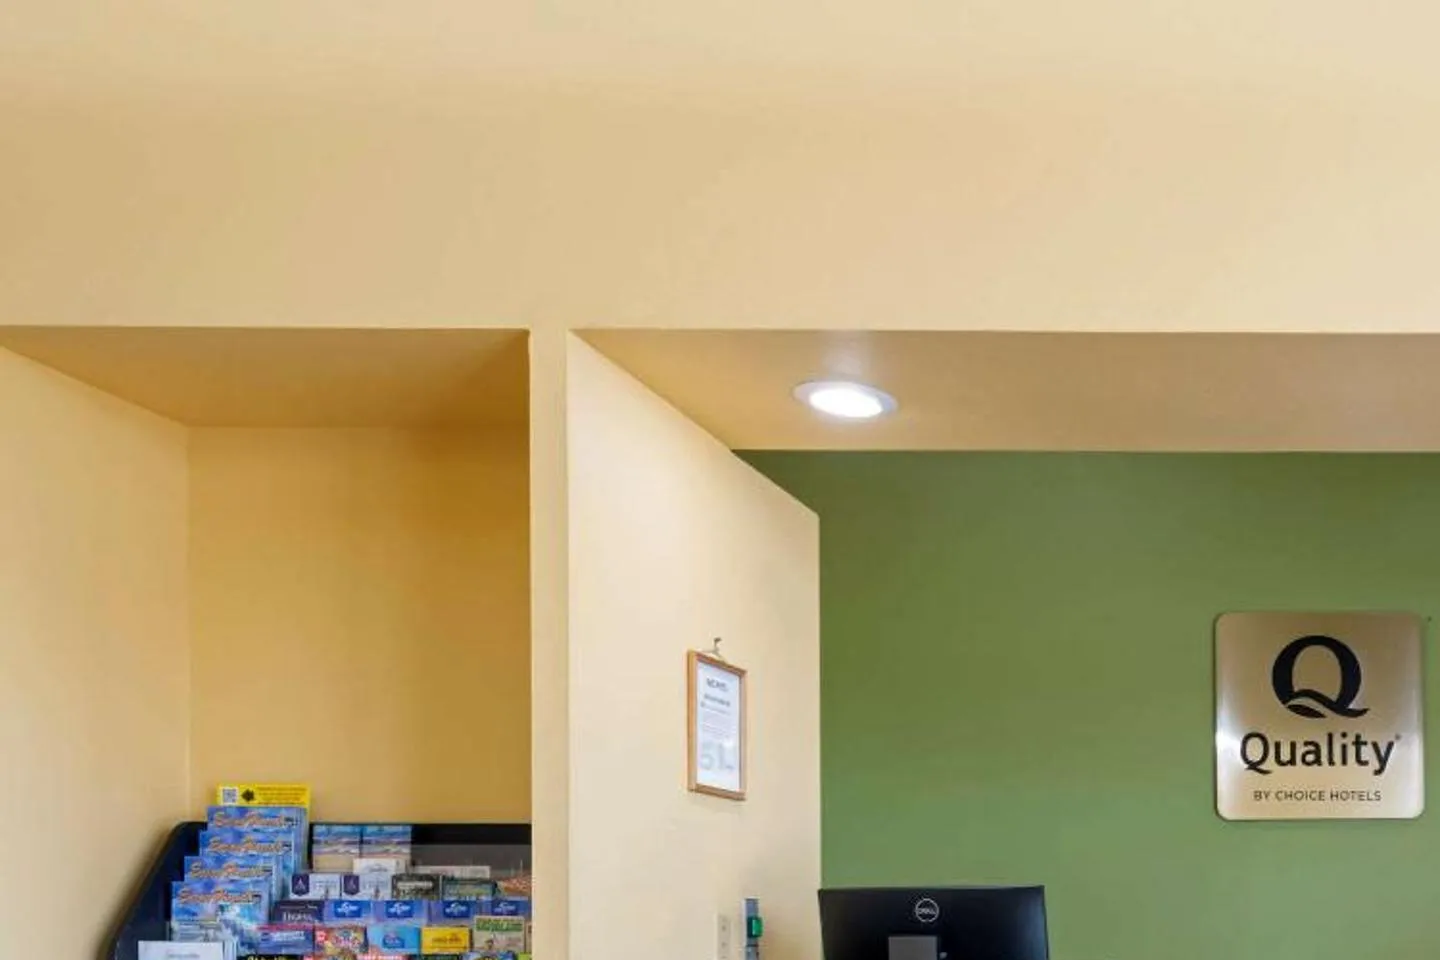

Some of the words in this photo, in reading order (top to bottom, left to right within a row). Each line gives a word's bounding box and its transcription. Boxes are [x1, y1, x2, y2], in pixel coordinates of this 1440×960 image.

[1272, 635, 1371, 719] Q
[1240, 732, 1395, 776] Quality
[1253, 790, 1271, 801] BY
[1275, 790, 1325, 801] CHOICE
[1330, 790, 1381, 801] HOTELS
